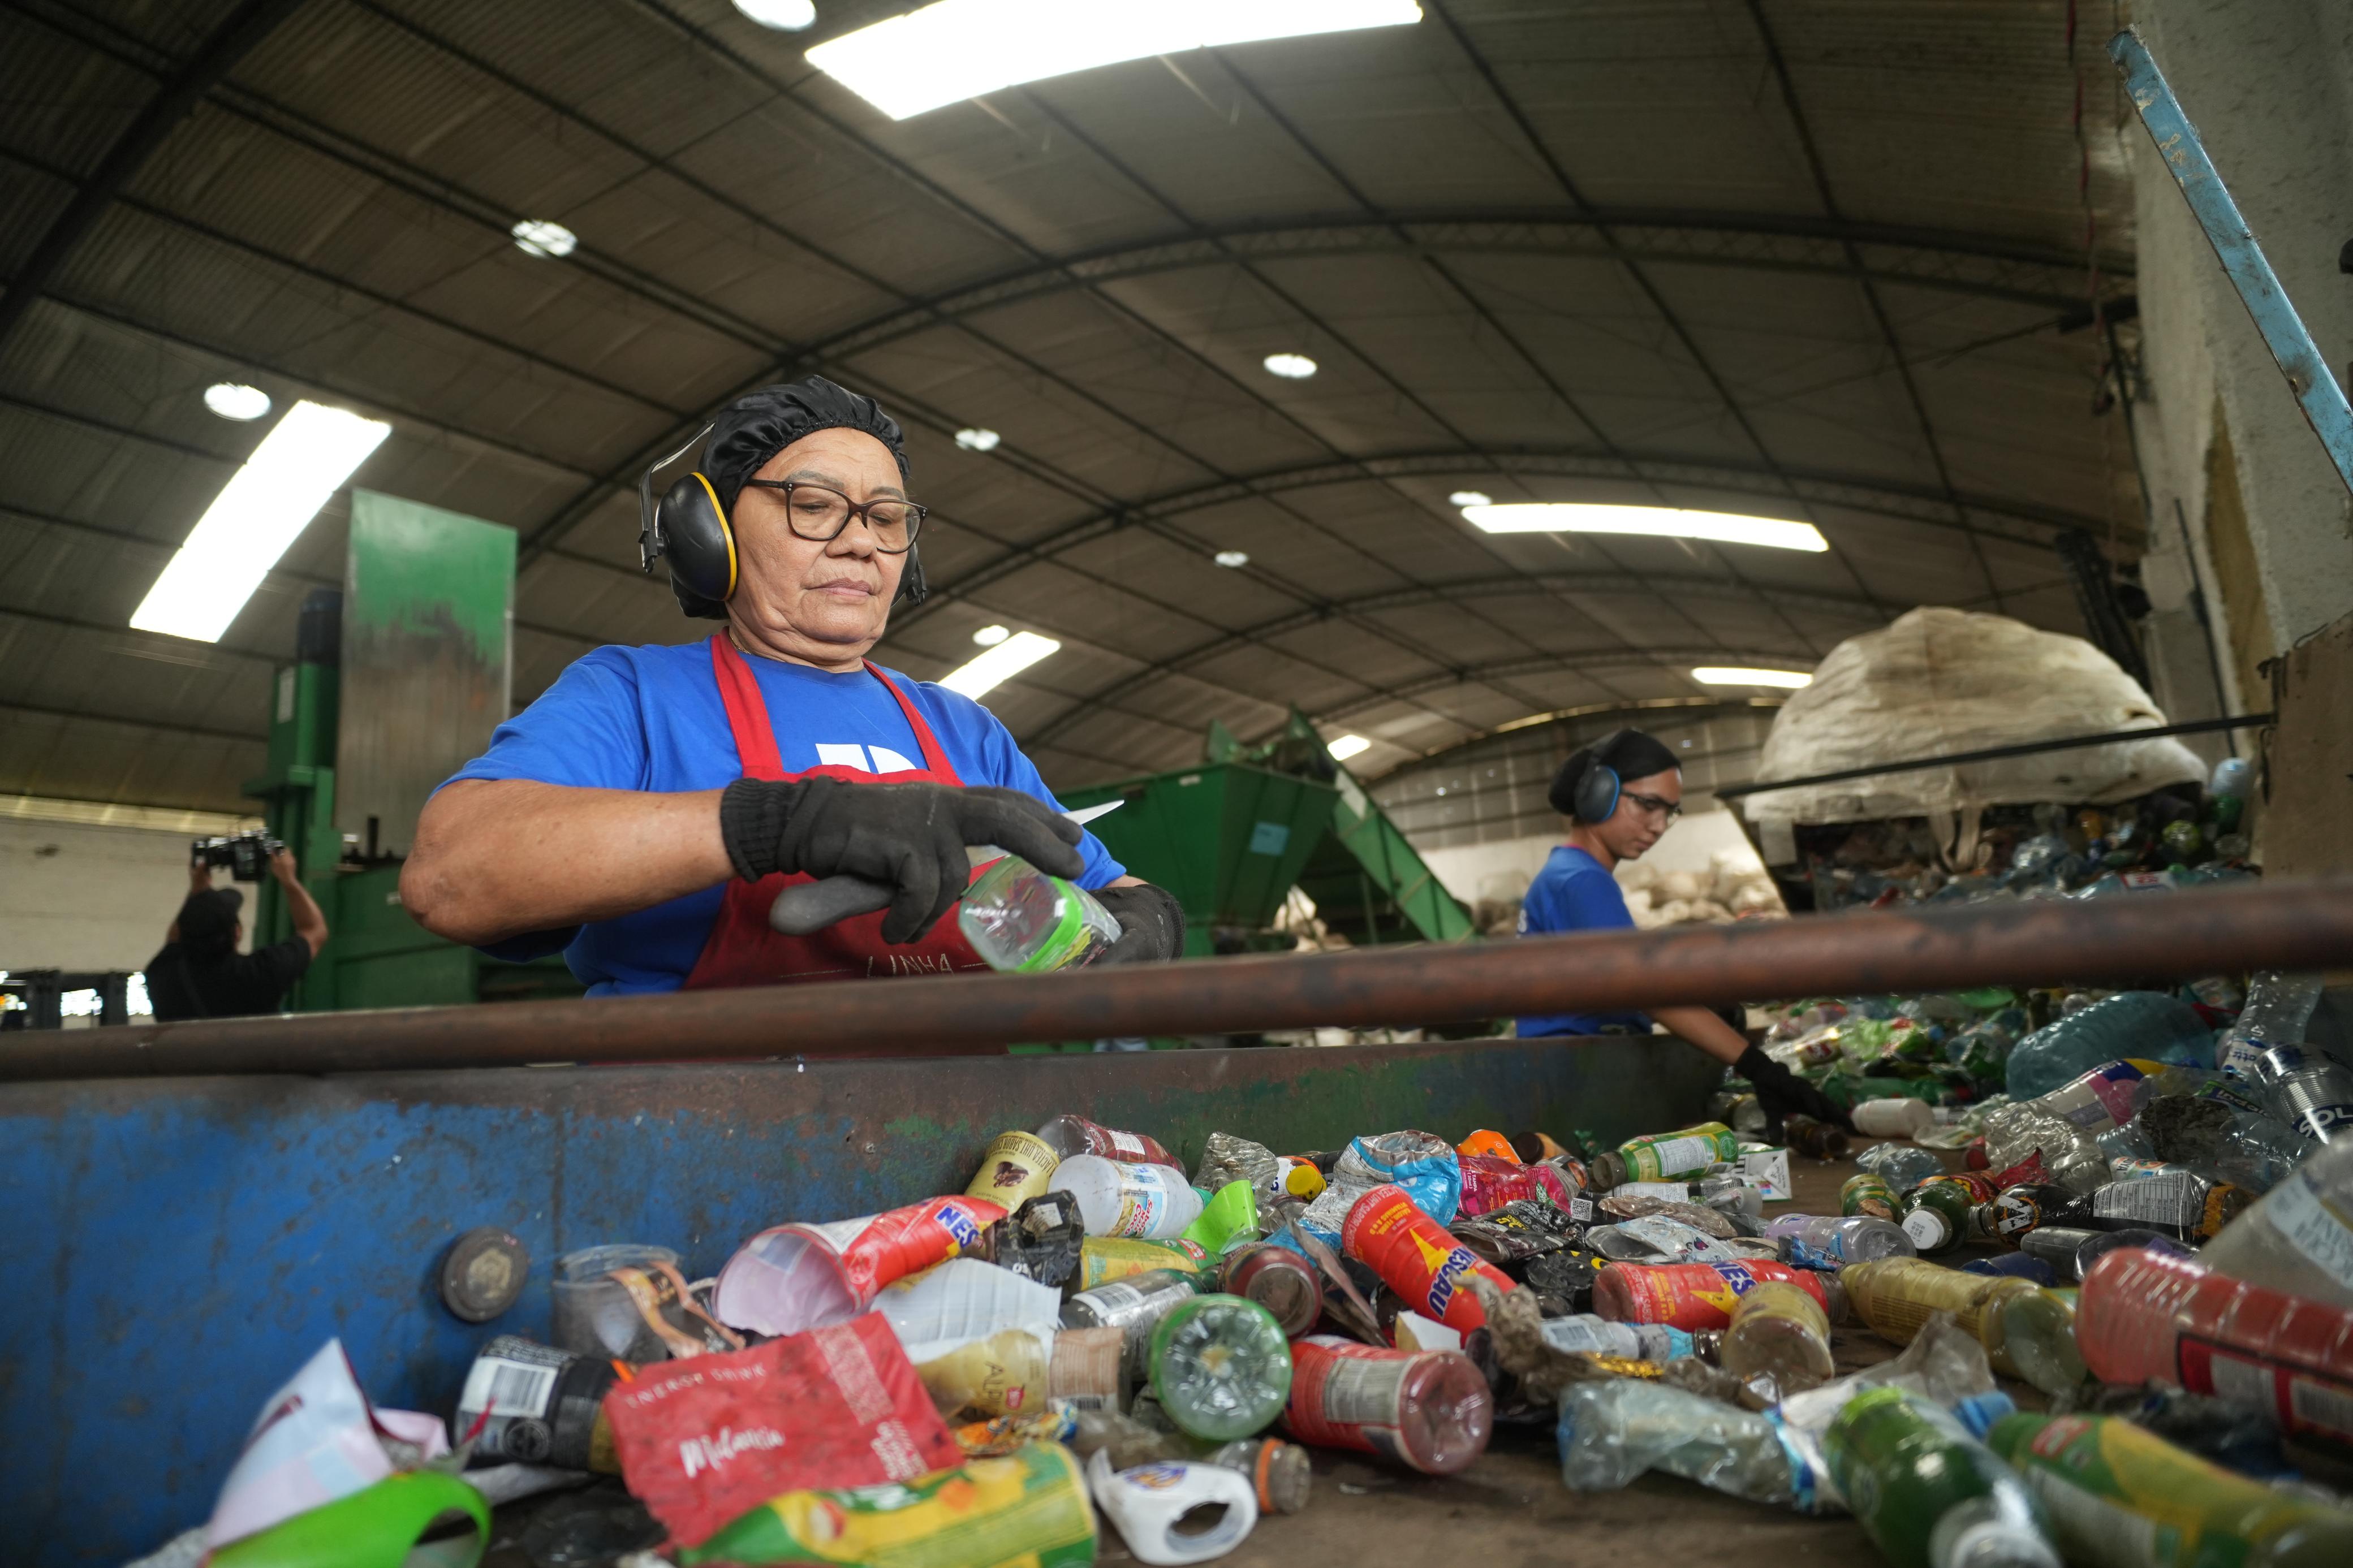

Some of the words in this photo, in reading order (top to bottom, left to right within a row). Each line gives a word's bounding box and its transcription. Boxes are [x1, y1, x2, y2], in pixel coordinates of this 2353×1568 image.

[867, 953, 955, 979] LINHA
[1124, 1204, 1142, 1235] Coco
[1353, 1203, 1370, 1226] SABOR
[1427, 1246, 1479, 1320] NESCAU
